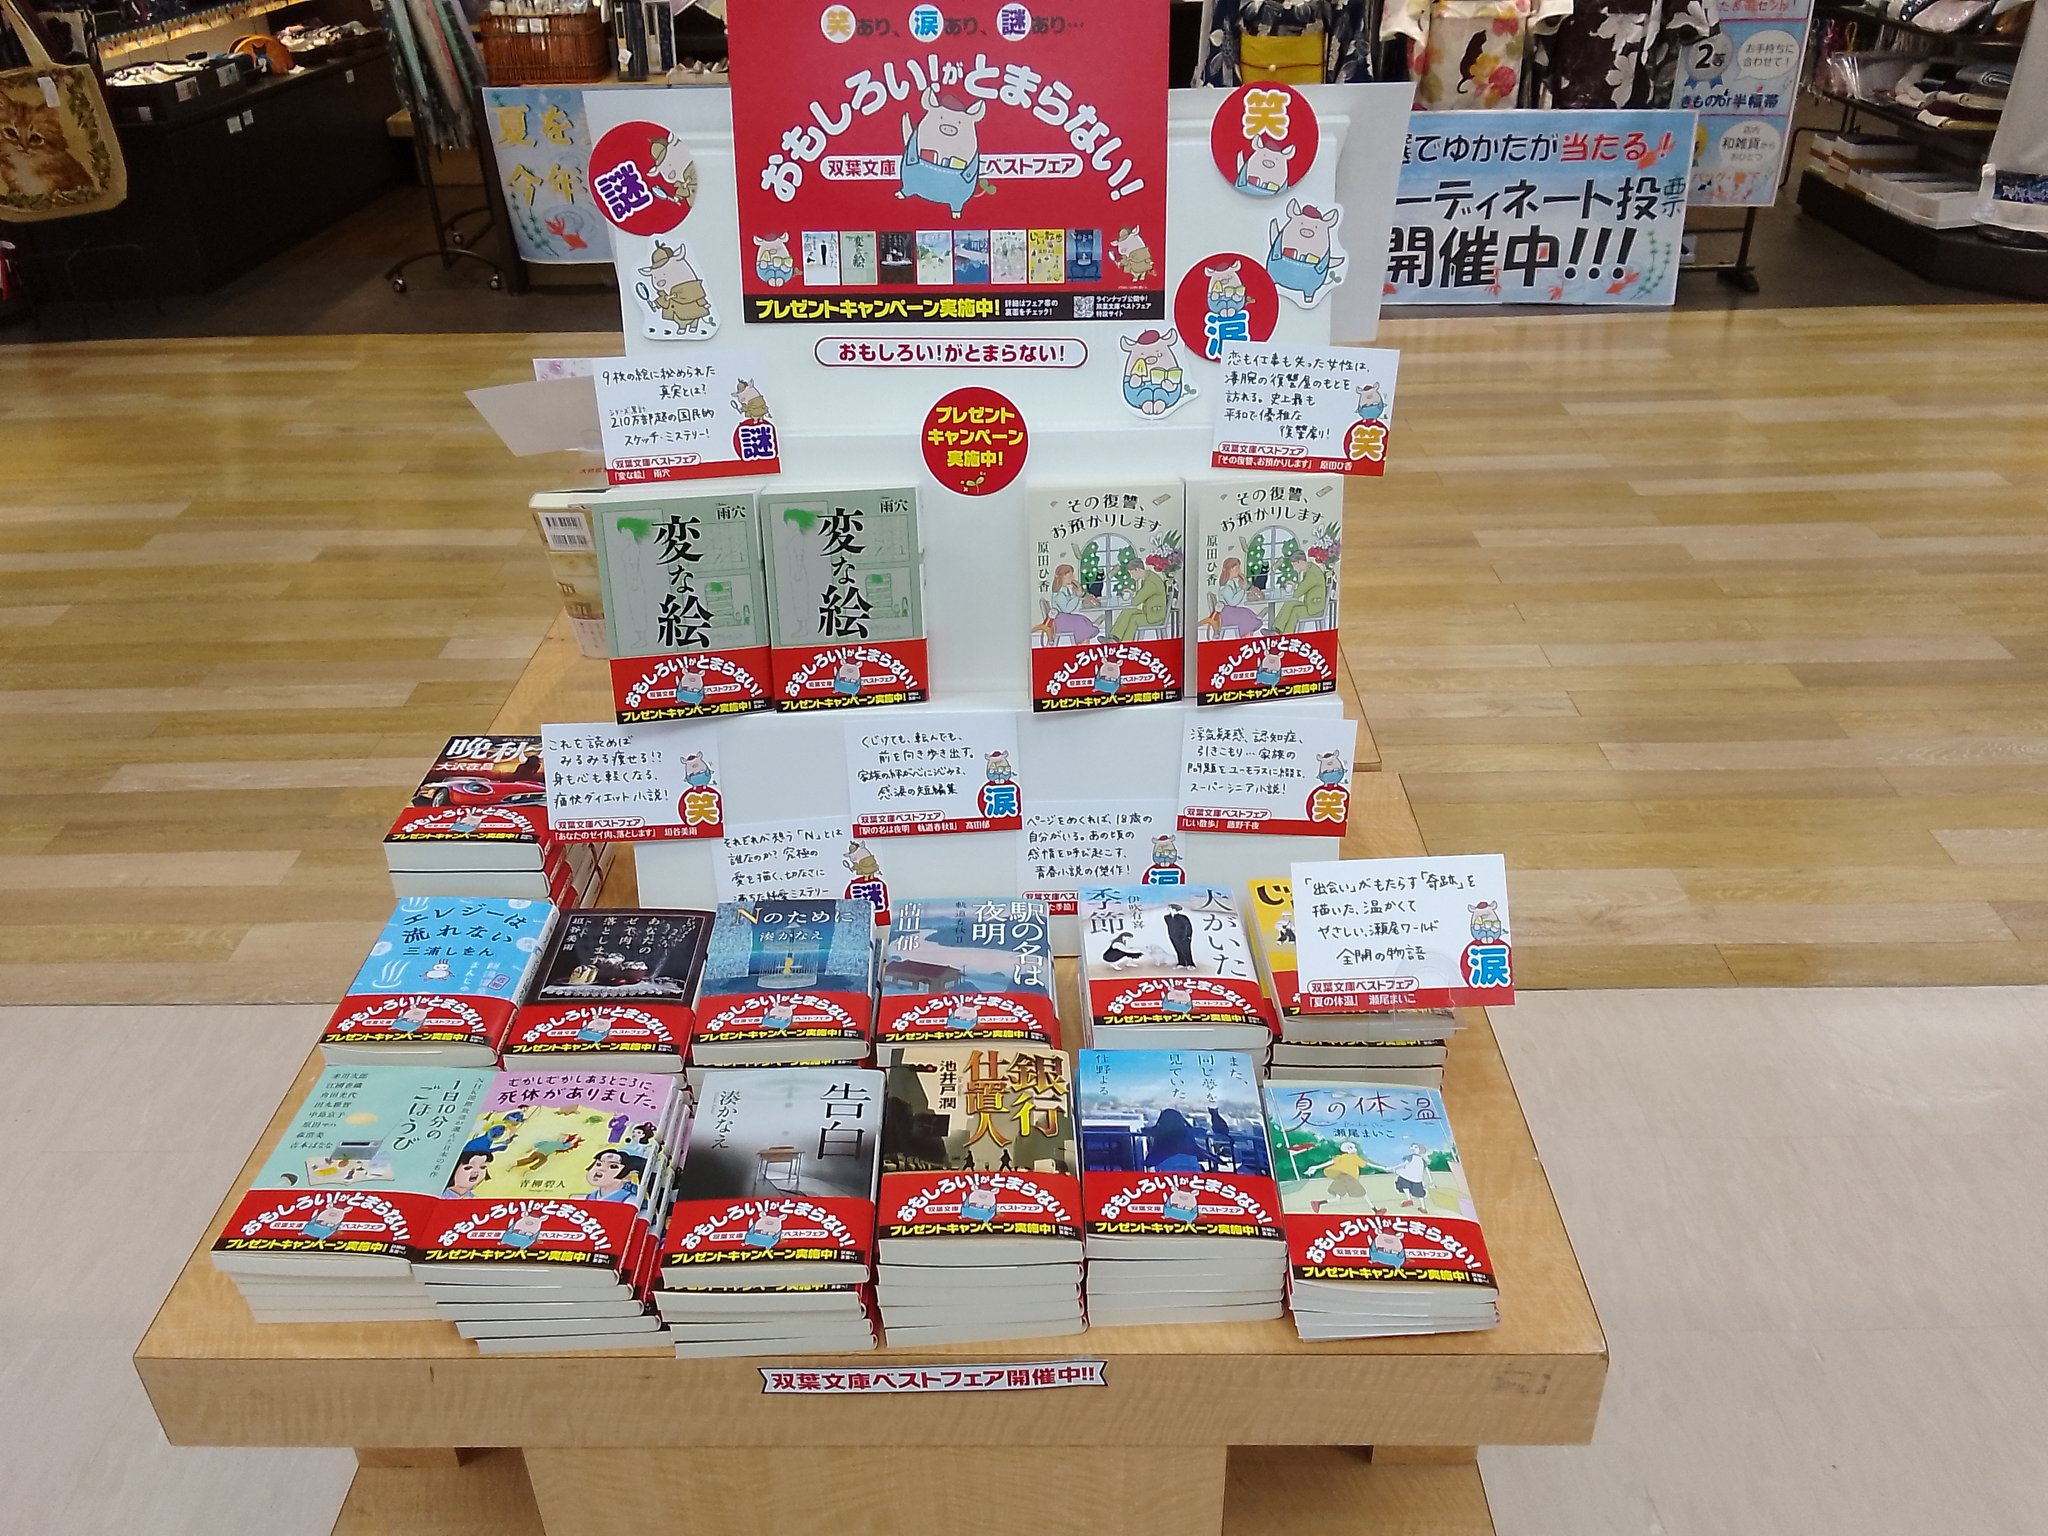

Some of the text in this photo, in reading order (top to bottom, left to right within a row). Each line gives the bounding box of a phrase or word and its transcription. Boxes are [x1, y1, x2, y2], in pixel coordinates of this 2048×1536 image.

[1743, 57, 1789, 67] 合わせて!
[1245, 91, 1289, 137] 笑
[828, 158, 1075, 176] 双葉文庫 ベストフェア
[597, 162, 651, 220] 謎
[1387, 226, 1637, 288] 開催中!!!
[756, 298, 1000, 319] プレゼントキャンペーン実施中!
[839, 343, 1065, 363] おもしろい!がとまらない!
[603, 366, 716, 385] 9枚の絵に秘められた
[659, 384, 707, 401] 真実とは?
[936, 407, 1015, 424] プレゼント
[1224, 408, 1302, 422] 平和で優雅な
[741, 426, 775, 459] 謎
[928, 429, 1023, 446] キャンペーン
[1351, 426, 1384, 461] 笑
[947, 450, 1003, 468] 実施中!
[1221, 445, 1305, 455] 双葉文庫ベストフェア
[615, 455, 699, 468] 双葉文庫ベストフェア
[1320, 462, 1353, 471] 原田ひ香
[654, 469, 671, 478] 雨穴
[716, 503, 746, 521] 雨穴
[879, 498, 909, 514] 雨穴
[1051, 514, 1162, 539] お預かりします
[1221, 507, 1324, 532] お預かりします
[1037, 541, 1049, 592] 原田ひ香
[1206, 534, 1218, 586] 原田ひ香
[652, 514, 714, 648] 変な絵
[816, 507, 874, 639] 変な絵
[549, 735, 633, 751] これを読めば
[1190, 727, 1303, 744] 浮気疑惑、認知症、
[446, 737, 544, 764] 晩秋
[878, 747, 974, 764] 前を向き歩き出す。
[436, 762, 494, 771] 大沢在昌
[877, 783, 958, 800] 感涙の短編集
[1190, 783, 1287, 795] スーパーシニア小説!
[554, 789, 669, 809] 痛快ダイエット小説!
[985, 787, 1017, 816] 涙
[1313, 792, 1346, 823] 笑
[685, 794, 718, 824] 笑
[861, 812, 941, 823] 双葉文庫ベストフェア
[1187, 808, 1268, 818] 双葉文庫ベストフェア
[558, 818, 641, 830] 双葉文庫ベストフェア
[665, 827, 698, 836] 垣谷美雨
[1028, 830, 1135, 843] 自分がいる。あの頃の
[732, 869, 825, 887] 愛を描く、切なさに
[1035, 865, 1131, 880] 青春小説の傑作!
[403, 903, 527, 929] エレジーは
[735, 908, 853, 925] Nのために
[1086, 887, 1125, 934] 季節
[1311, 900, 1417, 918] 描いた、温かくて
[971, 901, 1007, 945] 夜明
[402, 926, 513, 943] 流れない
[639, 917, 661, 954] あなたの
[760, 931, 824, 942] 湊かなえ
[1201, 889, 1247, 977] 犬がいた
[402, 946, 495, 957] 三浦しをん
[1009, 902, 1045, 987] 駅の名は
[1336, 944, 1426, 966] 全開の物語
[1470, 948, 1508, 986] 涙
[1311, 979, 1414, 993] 双葉文庫ベストフェア
[1369, 994, 1417, 1005] 瀬尾まいこ
[1169, 1054, 1186, 1099] 見ていた
[1229, 1056, 1248, 1085] また、
[938, 1060, 957, 1110] 池井戸潤
[963, 1050, 1012, 1147] 仕置人
[1007, 1053, 1070, 1137] 銀行
[712, 1090, 741, 1149] 湊かなえ
[1285, 1089, 1442, 1132] 夏の体温
[817, 1083, 872, 1160] 告白
[1333, 1128, 1395, 1139] 瀬尾まいこ
[519, 1179, 566, 1189] 青柳碧人
[771, 1366, 1095, 1390] 双葉文庫ベストフェア開催中!!
